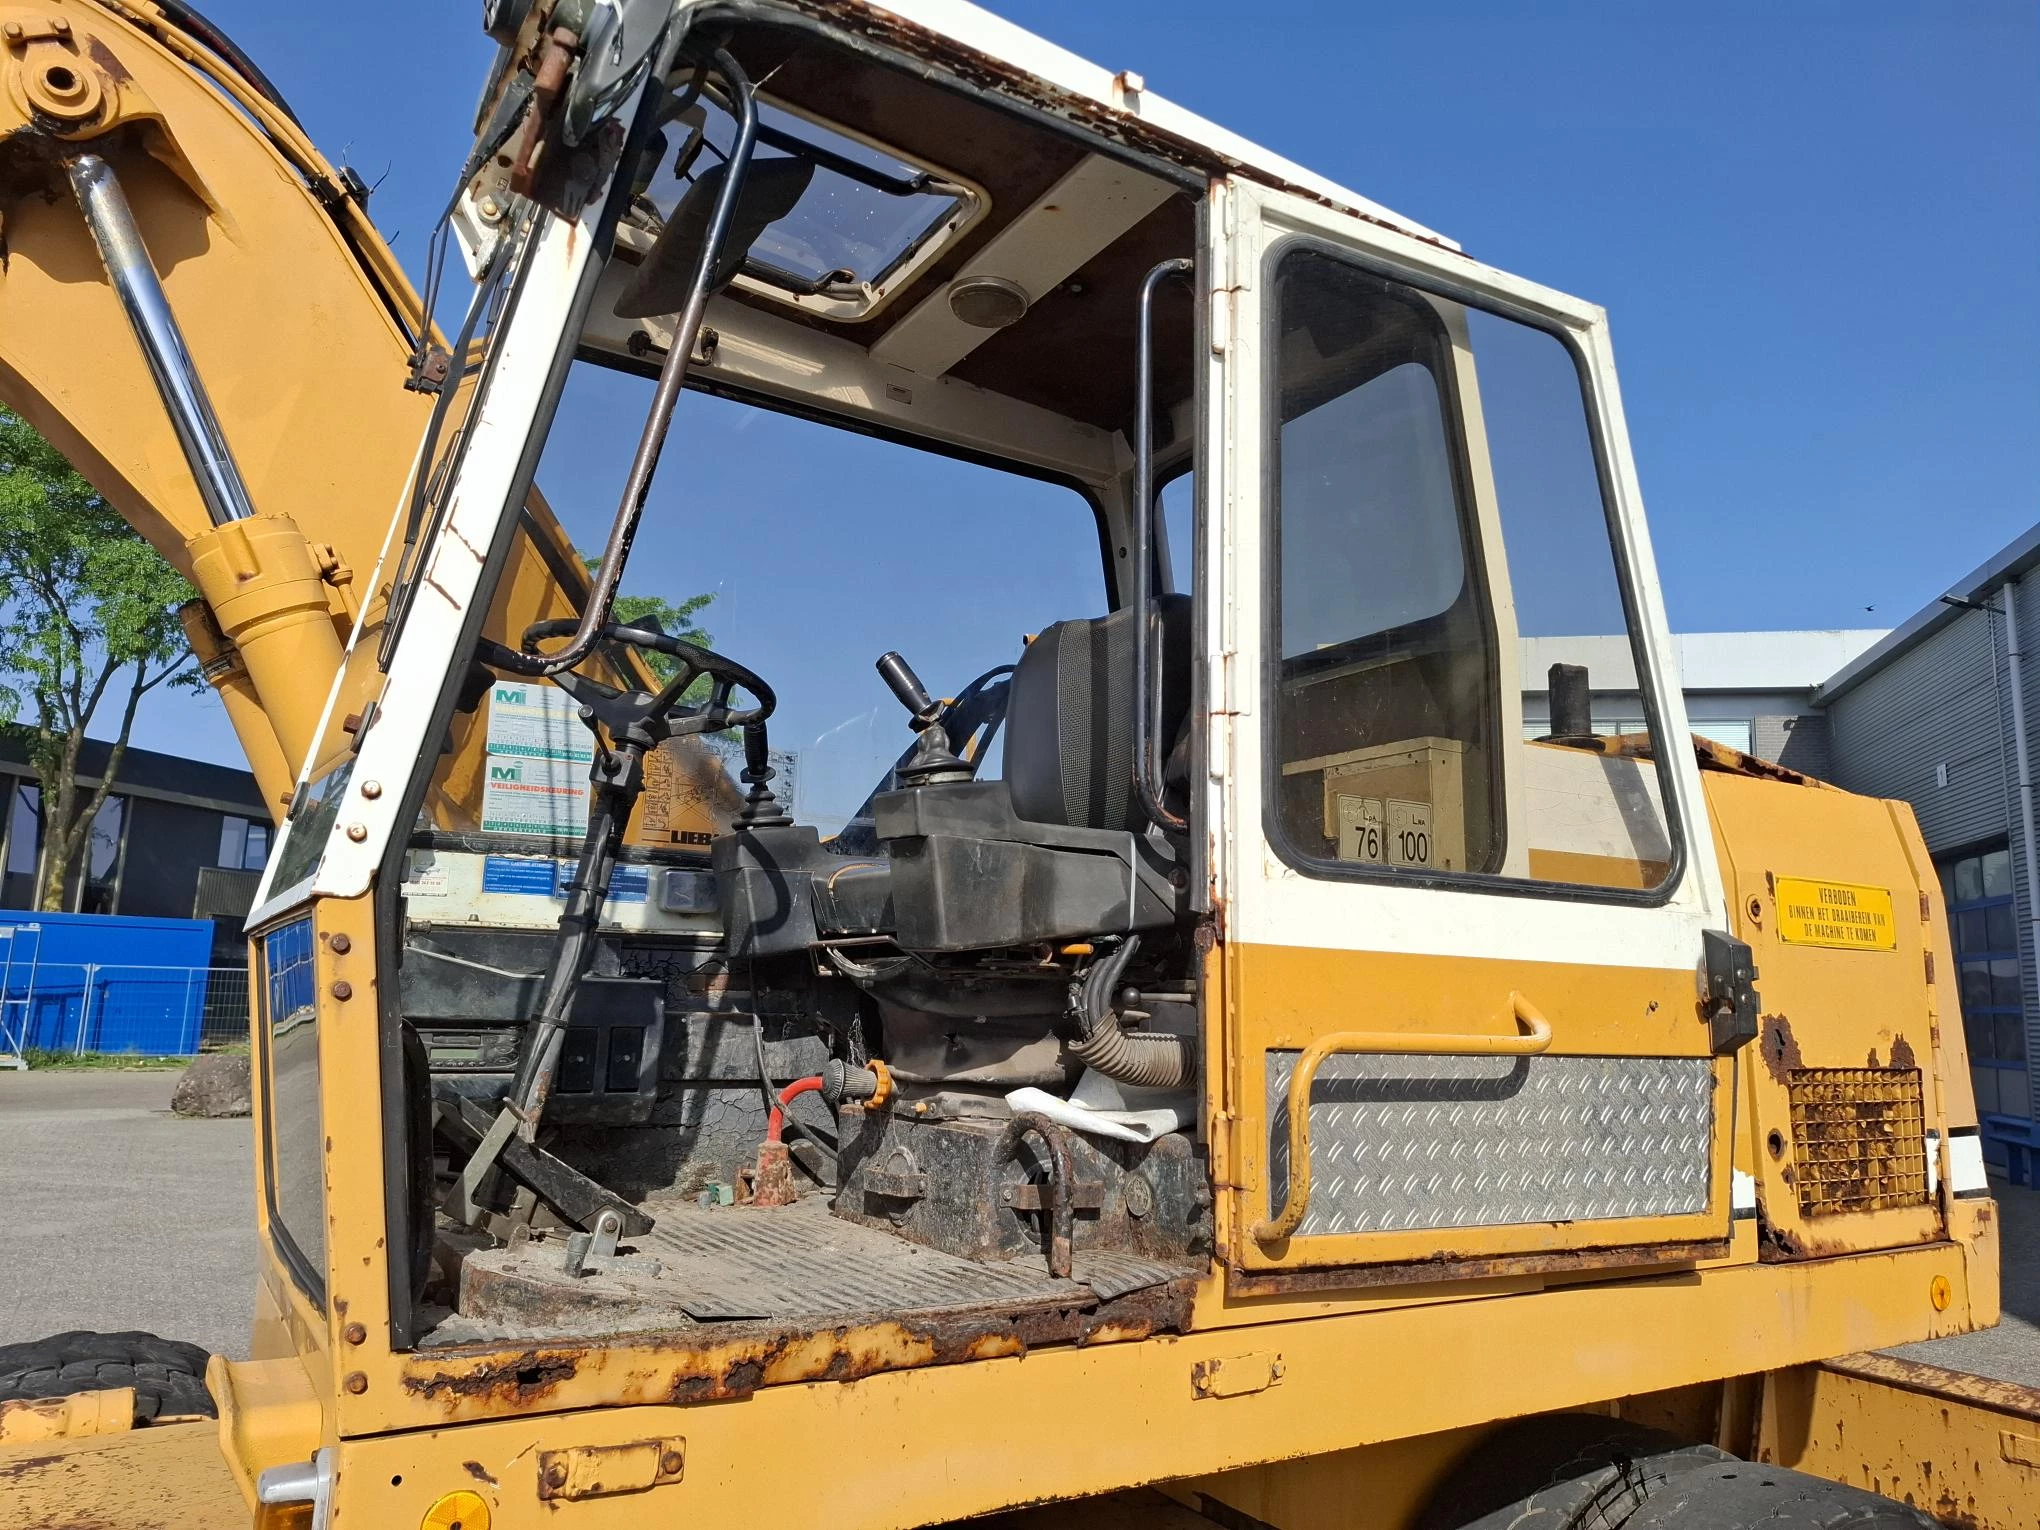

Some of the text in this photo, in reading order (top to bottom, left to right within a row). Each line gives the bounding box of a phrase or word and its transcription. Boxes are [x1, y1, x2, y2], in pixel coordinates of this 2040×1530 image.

[490, 782, 584, 796] VEILIGHEIDSKEURING
[671, 830, 719, 845] LIEB
[1355, 826, 1378, 859] 76
[1398, 830, 1428, 862] 100
[1818, 888, 1857, 906] VERBODEN
[1788, 905, 1885, 926] BINNEN HET DRAAIBEREIK VAN
[1804, 923, 1877, 942] DE MACHINE TE KOMEN
